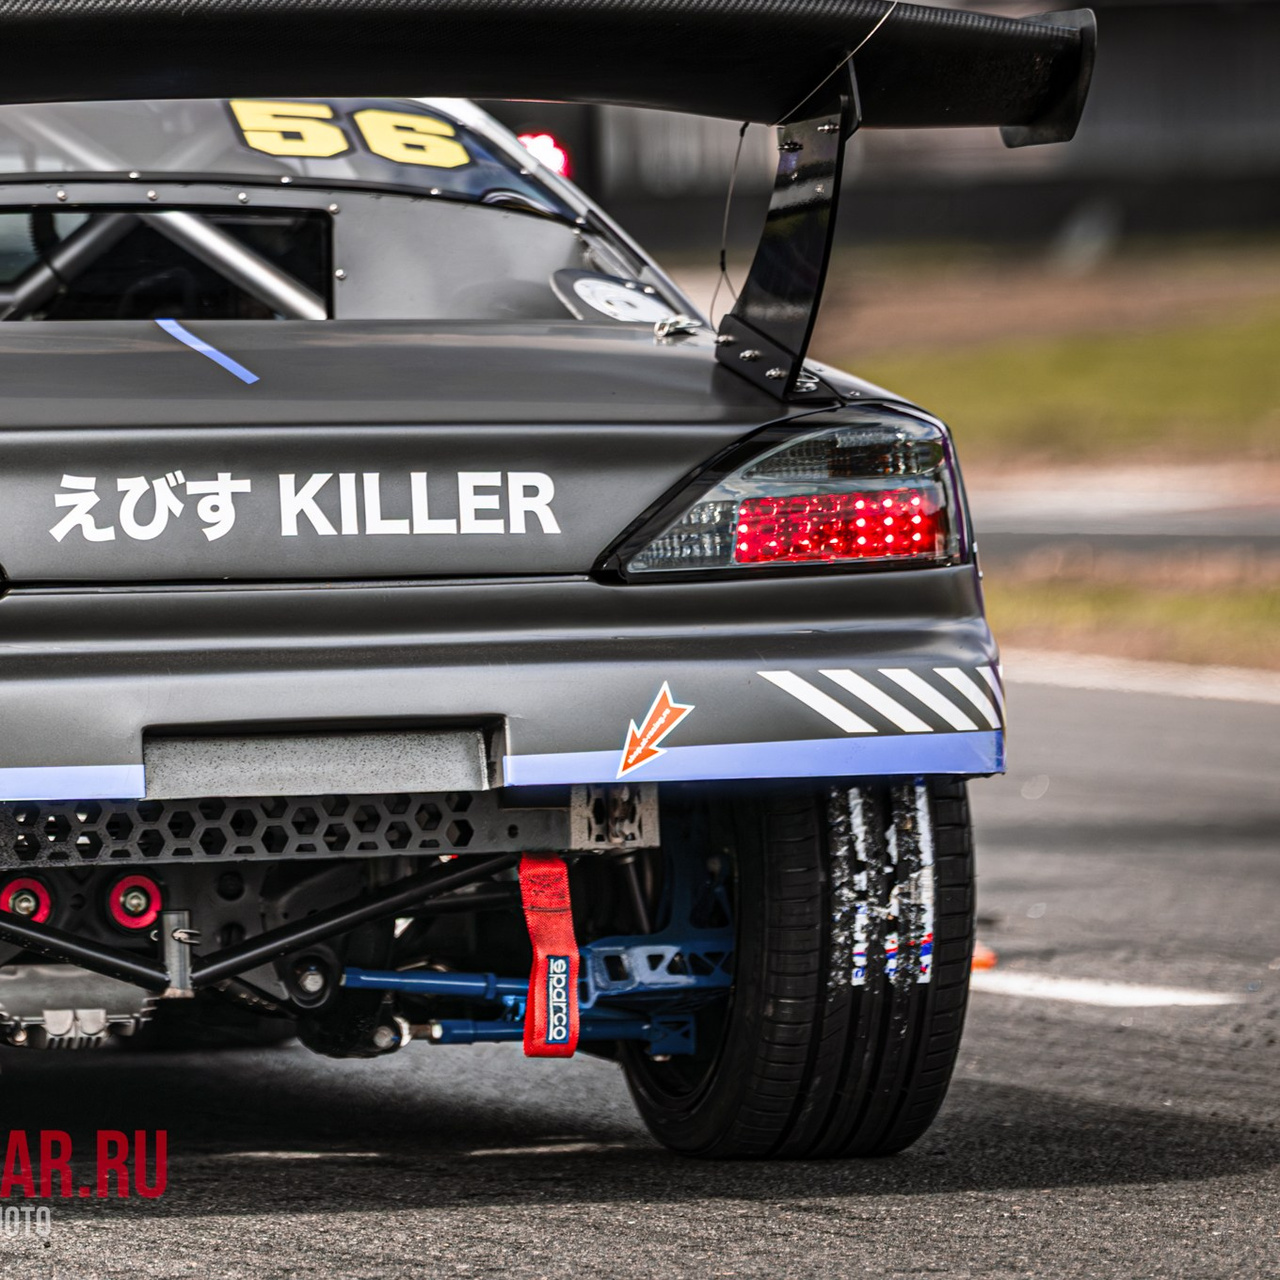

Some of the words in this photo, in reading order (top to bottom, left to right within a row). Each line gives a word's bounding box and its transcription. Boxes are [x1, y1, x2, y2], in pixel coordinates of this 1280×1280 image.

[229, 99, 471, 169] 56
[49, 470, 251, 543] えびす
[278, 471, 562, 537] KILLER
[548, 958, 568, 1041] sparco
